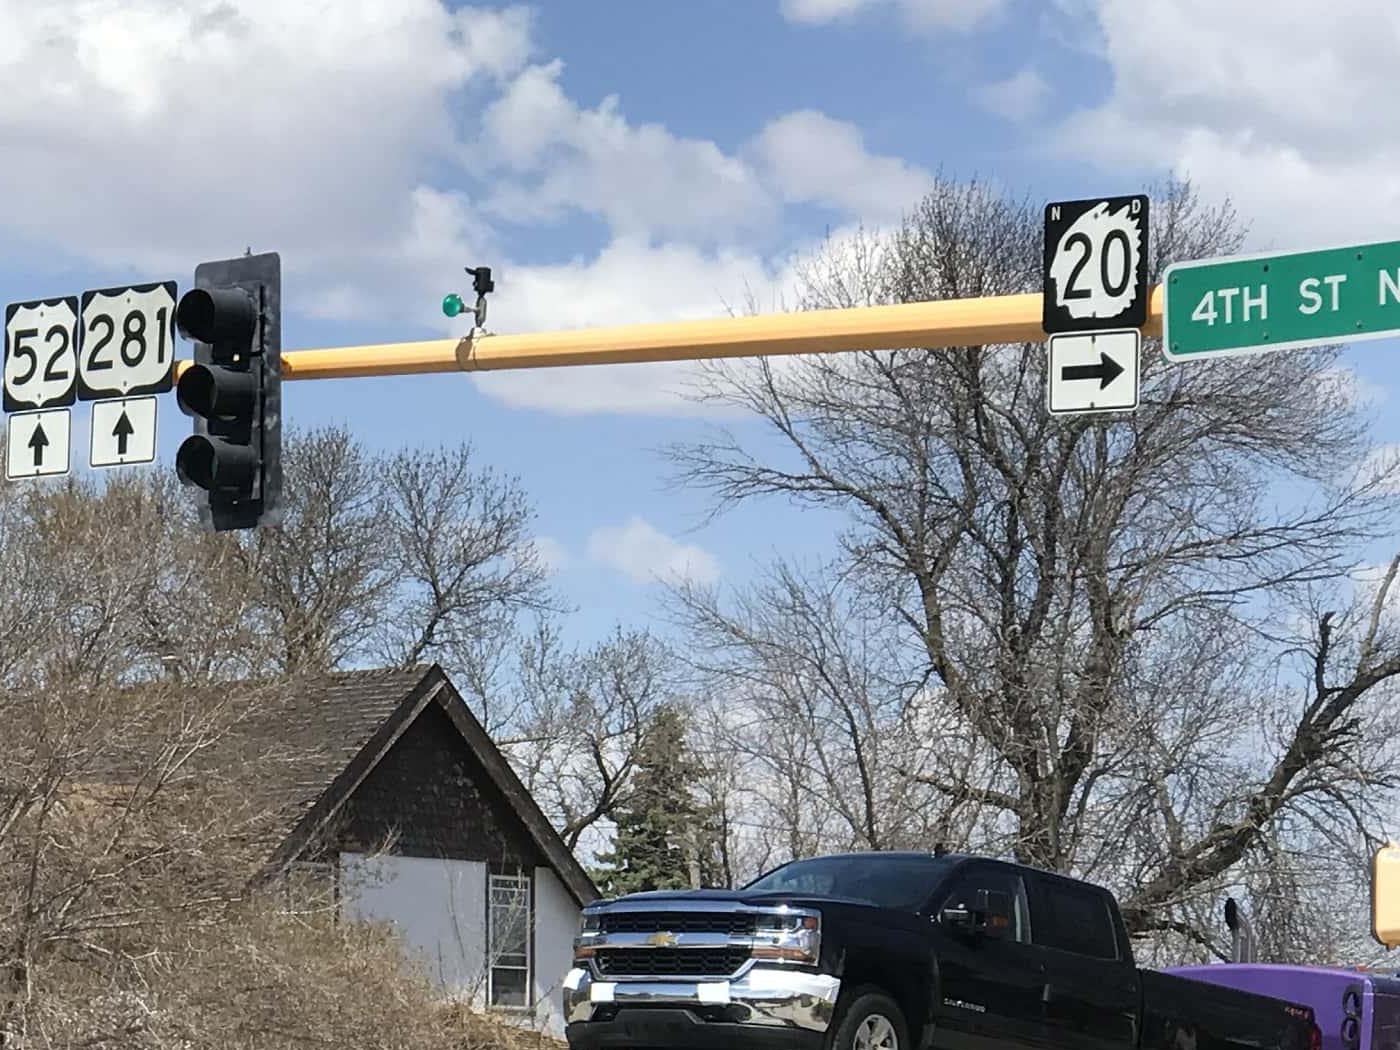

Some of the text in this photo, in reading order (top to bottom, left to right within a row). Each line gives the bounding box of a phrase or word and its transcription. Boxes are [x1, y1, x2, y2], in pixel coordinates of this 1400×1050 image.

[1051, 199, 1141, 221] N D
[1063, 228, 1132, 300] 20
[1191, 284, 1268, 326] 4TH
[1298, 274, 1347, 315] ST
[12, 324, 69, 386] 52
[86, 306, 167, 372] 281
